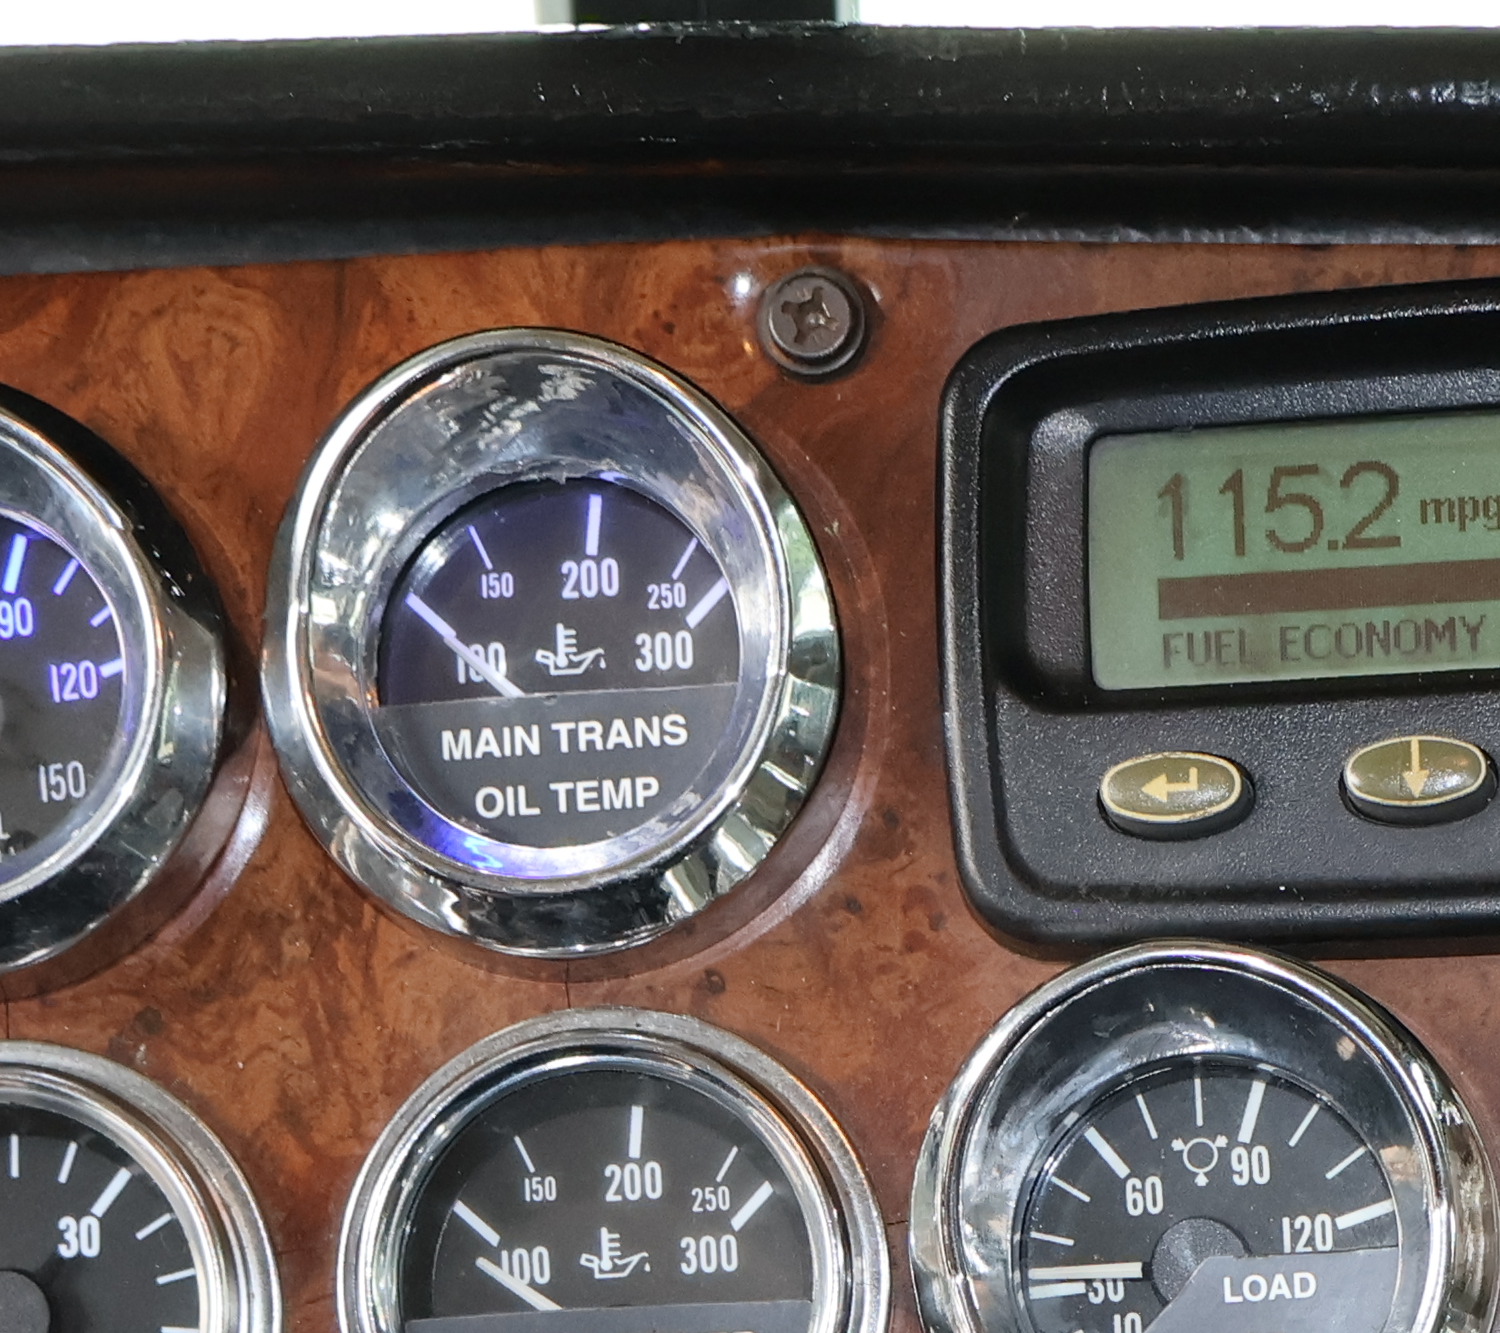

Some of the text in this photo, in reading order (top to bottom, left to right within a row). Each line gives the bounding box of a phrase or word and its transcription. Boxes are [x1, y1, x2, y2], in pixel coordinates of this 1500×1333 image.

[1157, 460, 1402, 560] 115.2
[481, 573, 514, 599] 150
[561, 557, 619, 600] 200
[647, 583, 686, 609] 250
[635, 630, 694, 671] 300
[1162, 614, 1487, 669] FUEL ECONOMY
[50, 660, 99, 703] 120
[441, 714, 688, 762] MAIN TRANS
[39, 760, 86, 803] 150
[475, 776, 660, 819] OIL TEMP
[604, 1161, 663, 1202] 200
[1231, 1146, 1270, 1186] 90
[524, 1177, 557, 1202] 150
[691, 1186, 730, 1213] 250
[1126, 1177, 1164, 1216] 60
[57, 1216, 100, 1257] 30
[1282, 1213, 1333, 1253] 120
[500, 1246, 551, 1285] 100
[680, 1234, 738, 1275] 300
[1223, 1272, 1317, 1305] LOAD
